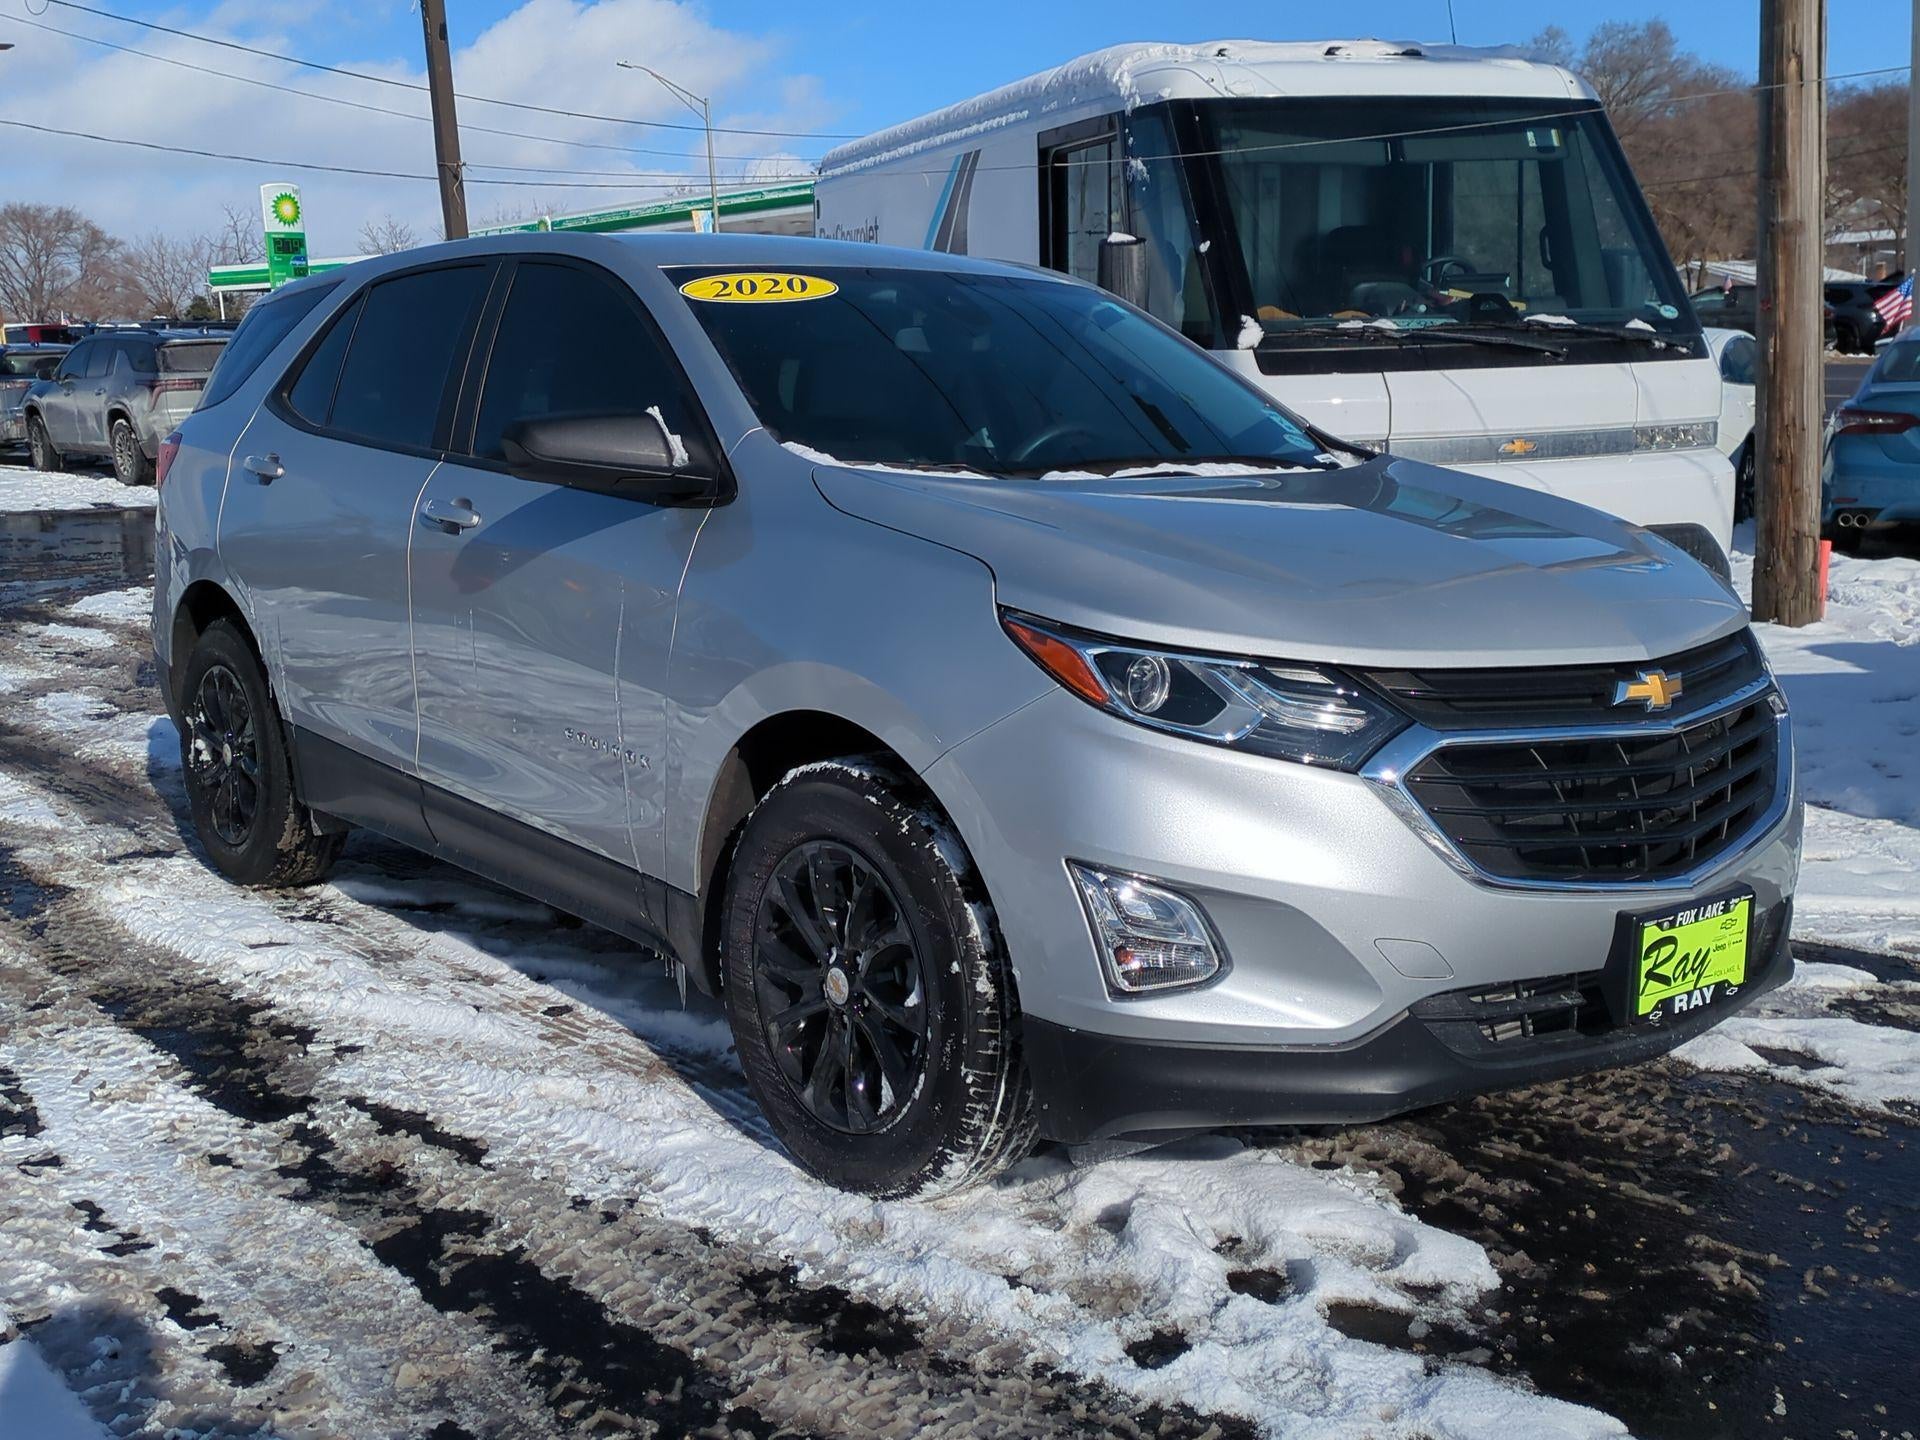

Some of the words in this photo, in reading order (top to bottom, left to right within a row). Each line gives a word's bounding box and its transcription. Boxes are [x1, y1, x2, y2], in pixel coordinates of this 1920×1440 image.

[710, 276, 808, 298] 2020
[1675, 909, 1697, 927] FOX
[1699, 900, 1726, 921] LAKE
[1640, 935, 1712, 997] Ray
[1674, 985, 1716, 1014] RAY
